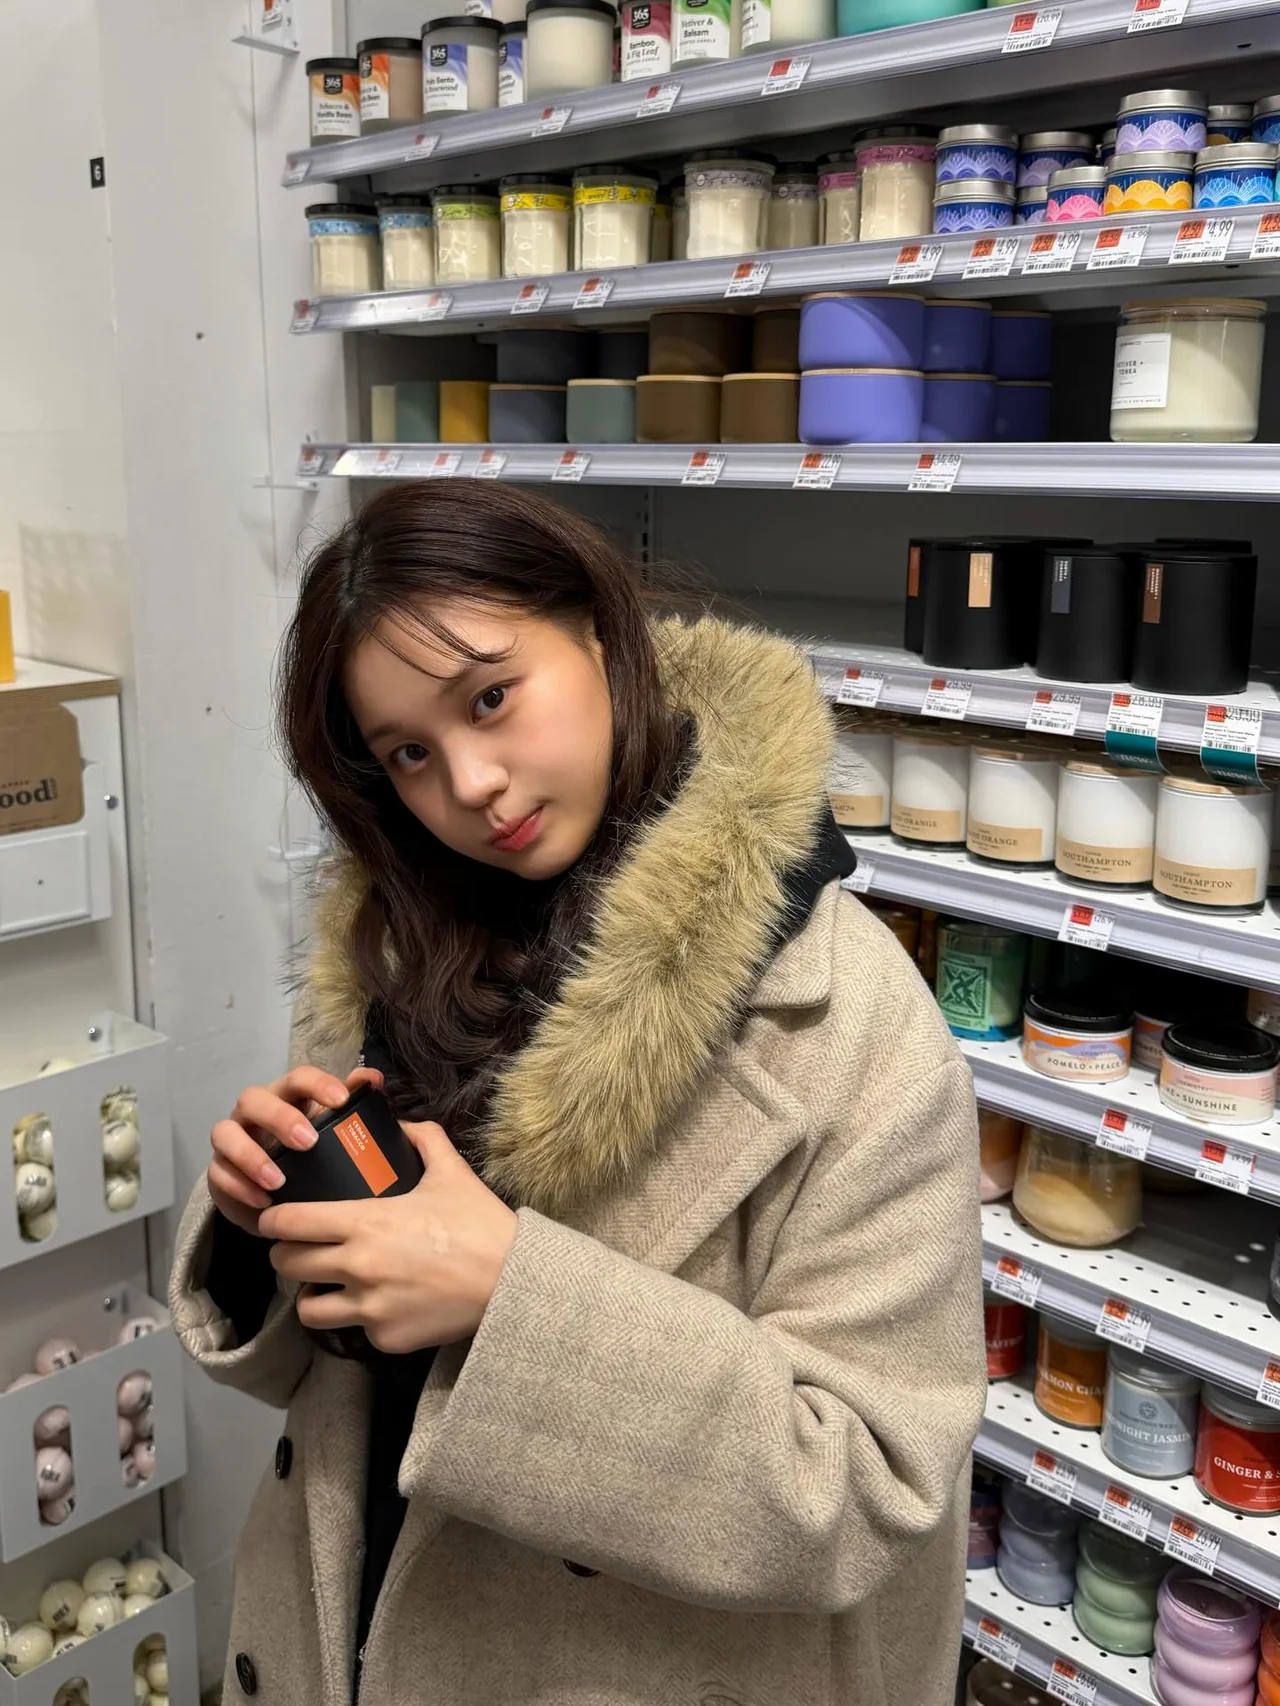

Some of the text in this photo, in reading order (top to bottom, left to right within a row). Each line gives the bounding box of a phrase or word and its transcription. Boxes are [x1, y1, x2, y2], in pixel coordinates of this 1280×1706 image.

[633, 8, 649, 22] 365
[706, 18, 713, 26] &
[684, 29, 709, 38] Balsam
[630, 41, 655, 50] Bamboo
[431, 48, 446, 60] 365
[632, 50, 640, 59] Fig
[642, 47, 659, 56] Leaf
[325, 78, 341, 88] 365
[903, 817, 938, 828] ORANGE
[981, 833, 1018, 847] ORANGE
[1063, 850, 1131, 867] SOUTHAMPTON
[1160, 868, 1233, 889] SOUTHAMPTON
[1047, 1057, 1086, 1070] POMELO
[1182, 1095, 1237, 1111] SUNSHINE
[348, 1124, 366, 1150] TOBACCO
[1214, 1456, 1261, 1479] GINGER
[1265, 1470, 1273, 1479] &
